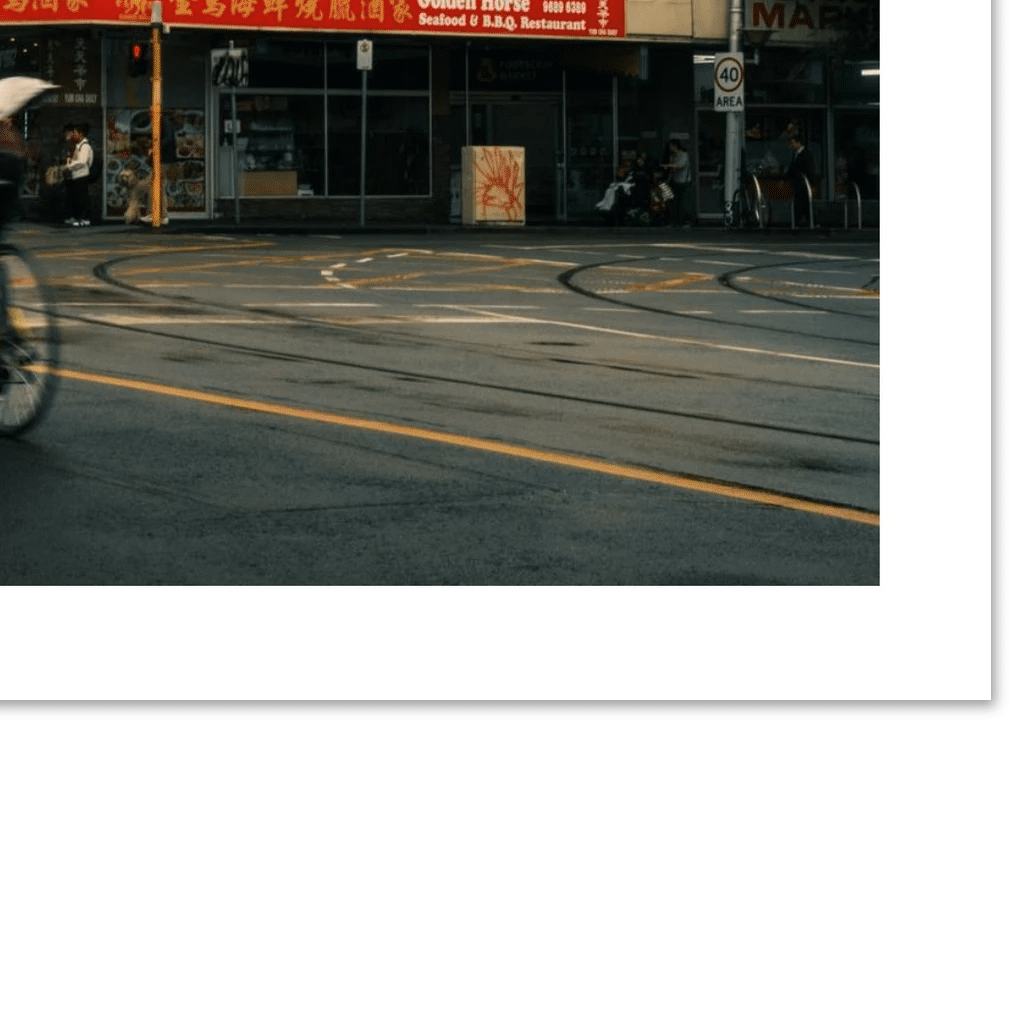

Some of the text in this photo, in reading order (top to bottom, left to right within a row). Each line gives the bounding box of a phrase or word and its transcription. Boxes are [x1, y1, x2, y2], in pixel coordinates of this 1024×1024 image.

[418, 12, 466, 27] Seafood
[482, 14, 518, 31] B.B.Q.
[520, 18, 587, 31] Restaurant
[719, 67, 738, 83] 40
[716, 96, 743, 107] AREA
